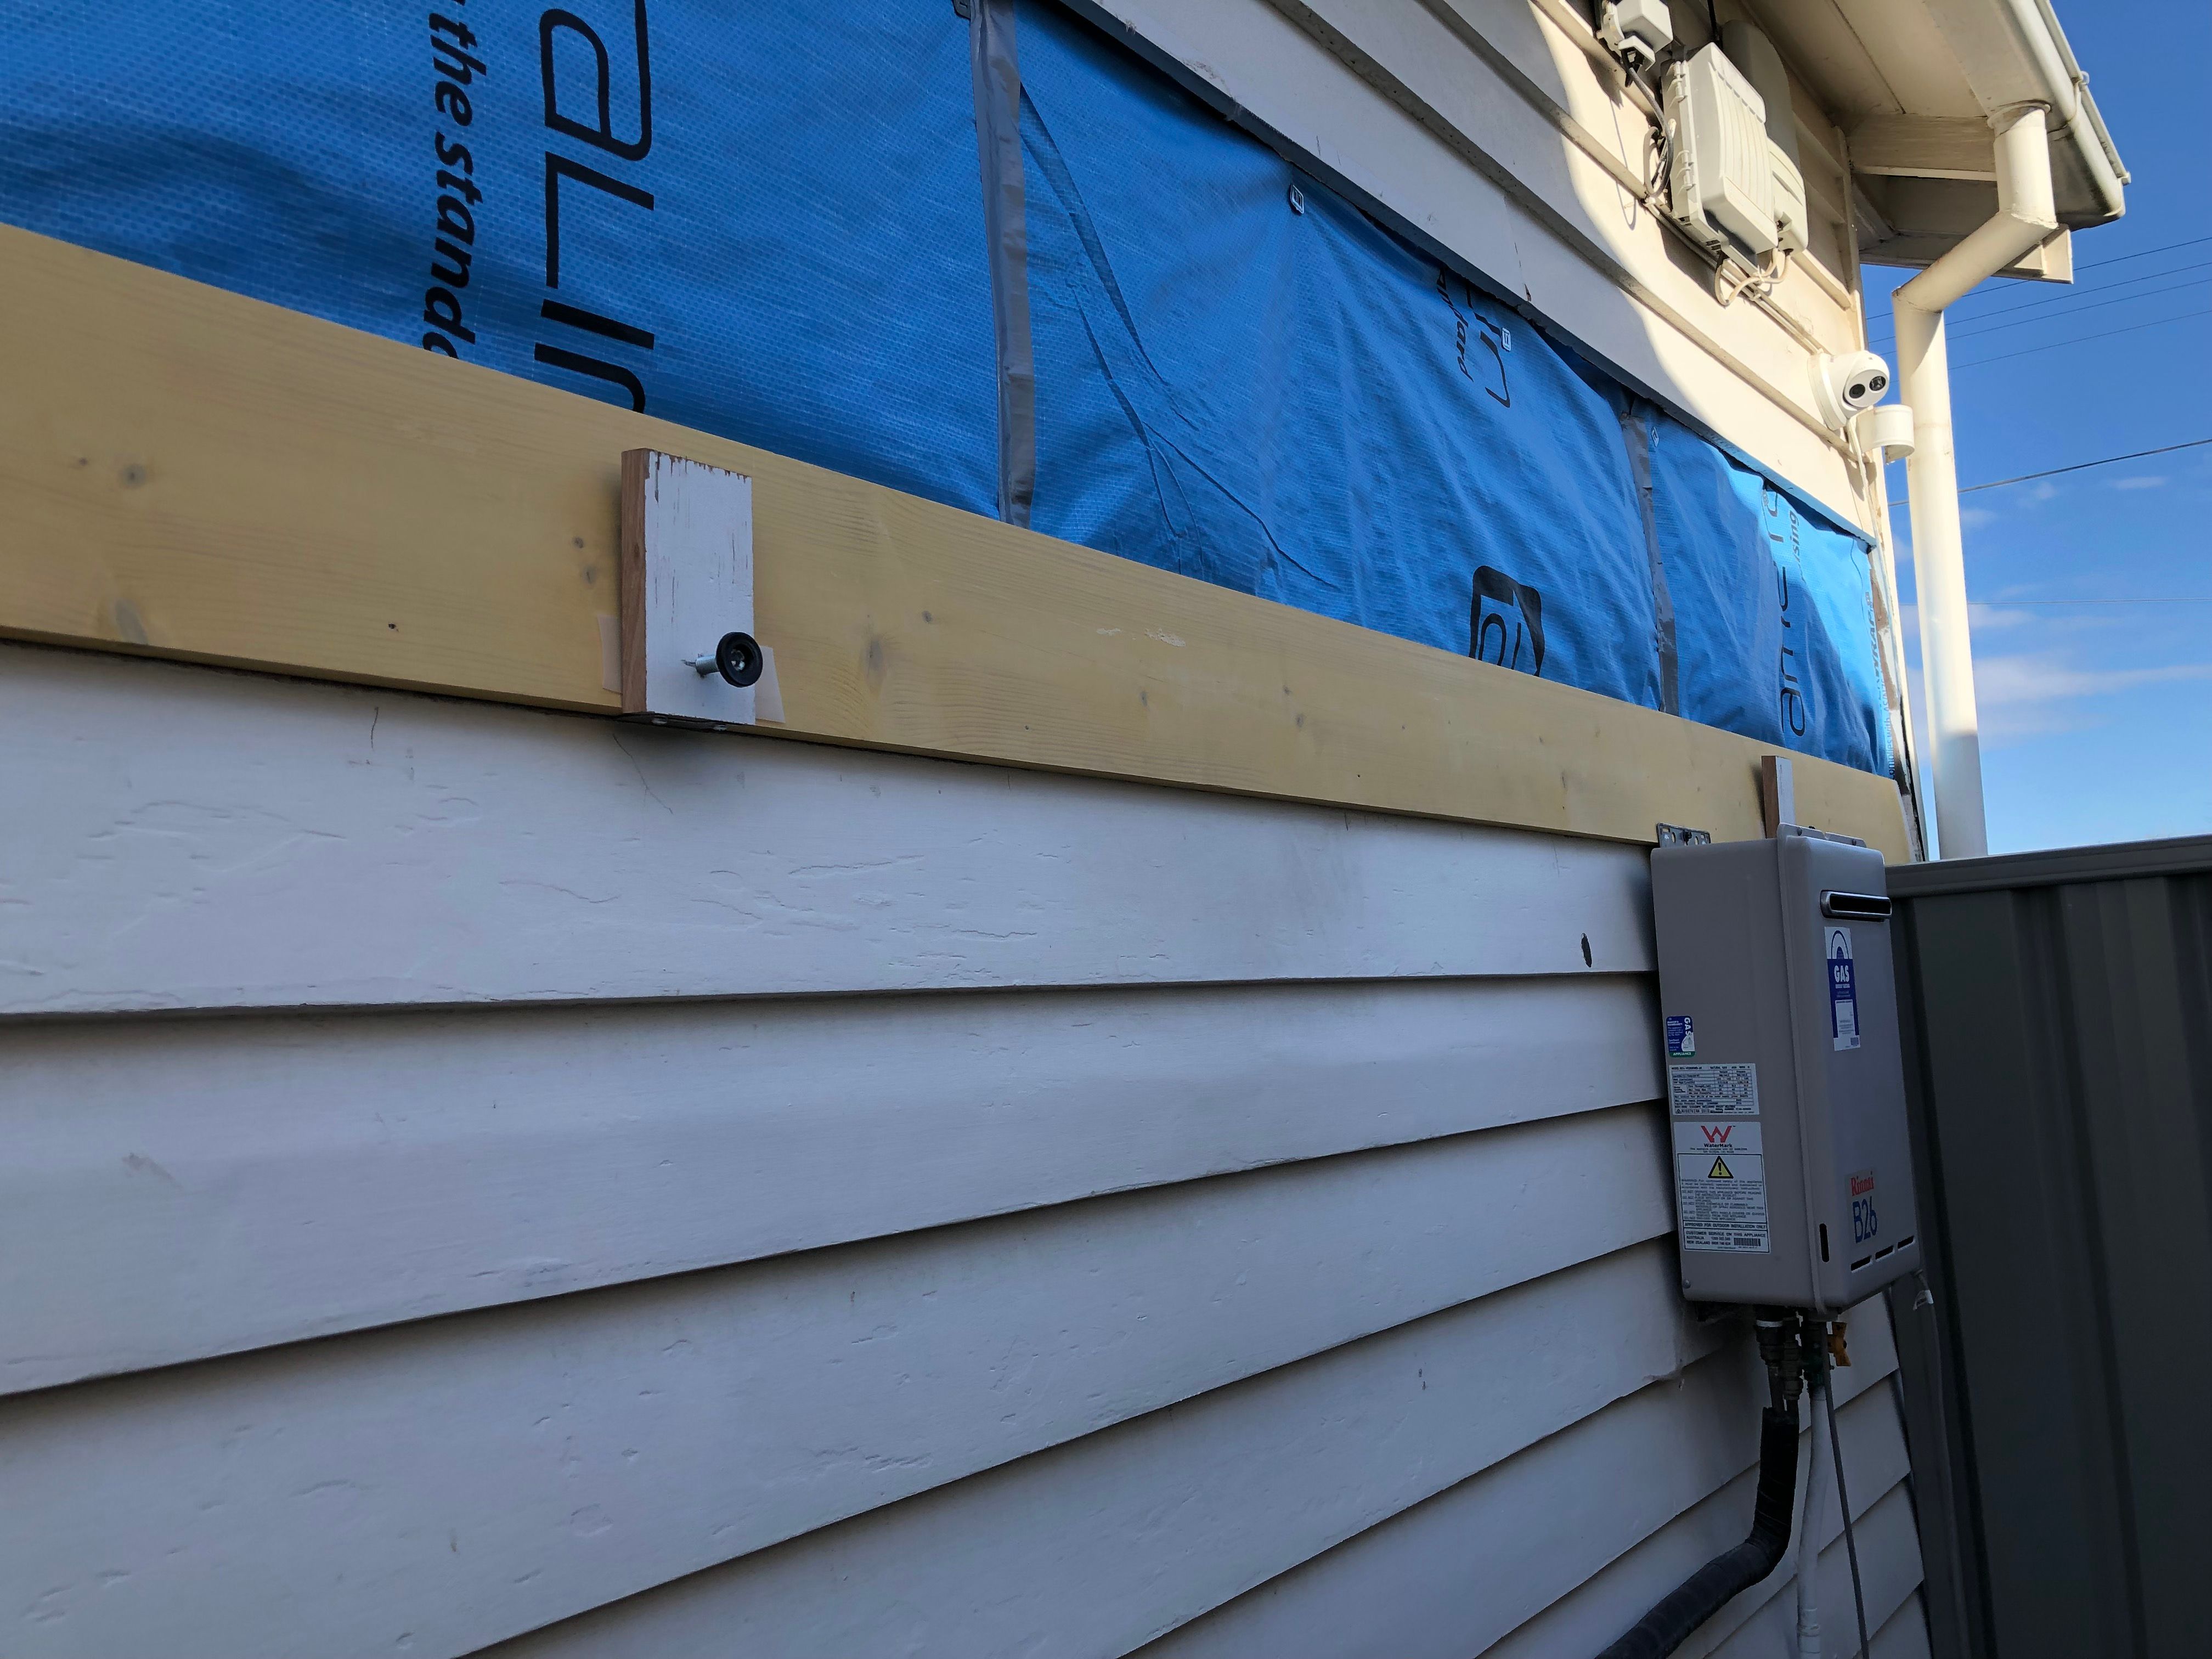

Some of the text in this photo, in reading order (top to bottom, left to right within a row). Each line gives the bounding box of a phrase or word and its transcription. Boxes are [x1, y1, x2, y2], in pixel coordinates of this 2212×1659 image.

[428, 13, 487, 127] the
[1834, 965, 1849, 983] GAS
[1851, 1171, 1874, 1197] Rinnai
[1853, 1196, 1877, 1243] B26
